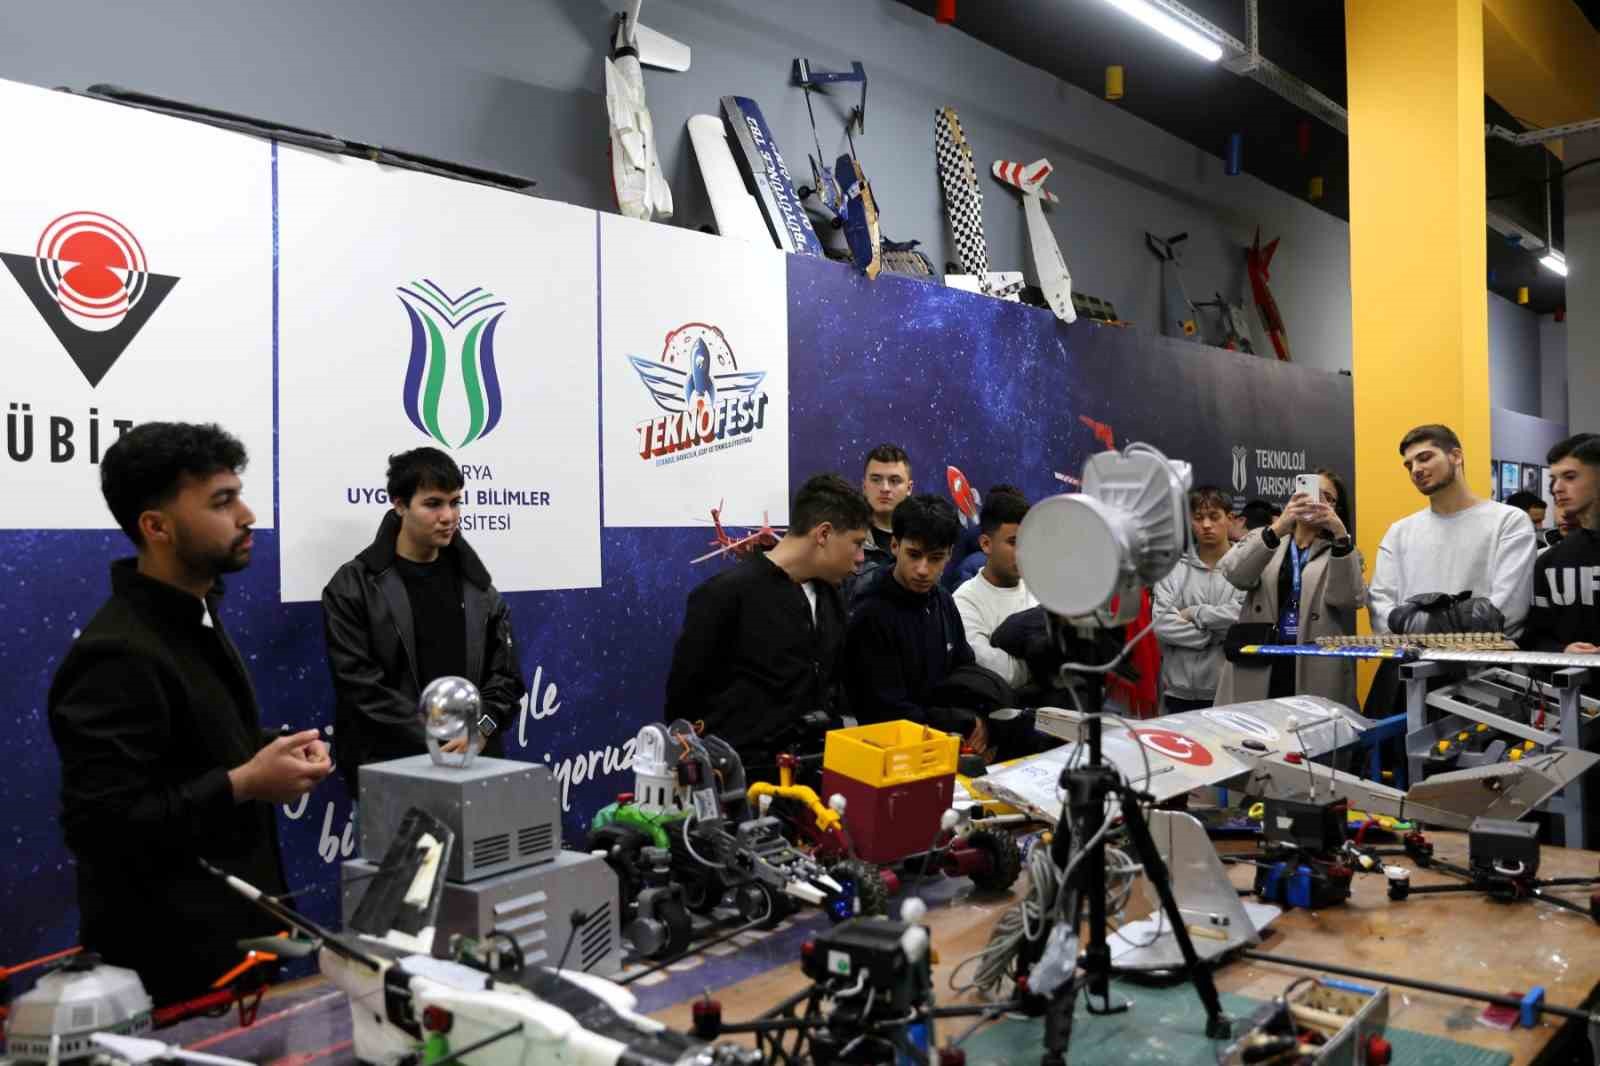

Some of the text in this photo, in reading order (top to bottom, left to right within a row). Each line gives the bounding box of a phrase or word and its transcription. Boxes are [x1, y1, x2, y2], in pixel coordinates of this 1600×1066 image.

[746, 116, 766, 146] TB2
[635, 391, 768, 460] TEKNOFEST
[1256, 449, 1306, 470] TEKNOLOJİ
[461, 464, 493, 480] RYA
[477, 488, 550, 506] BİLİMLER
